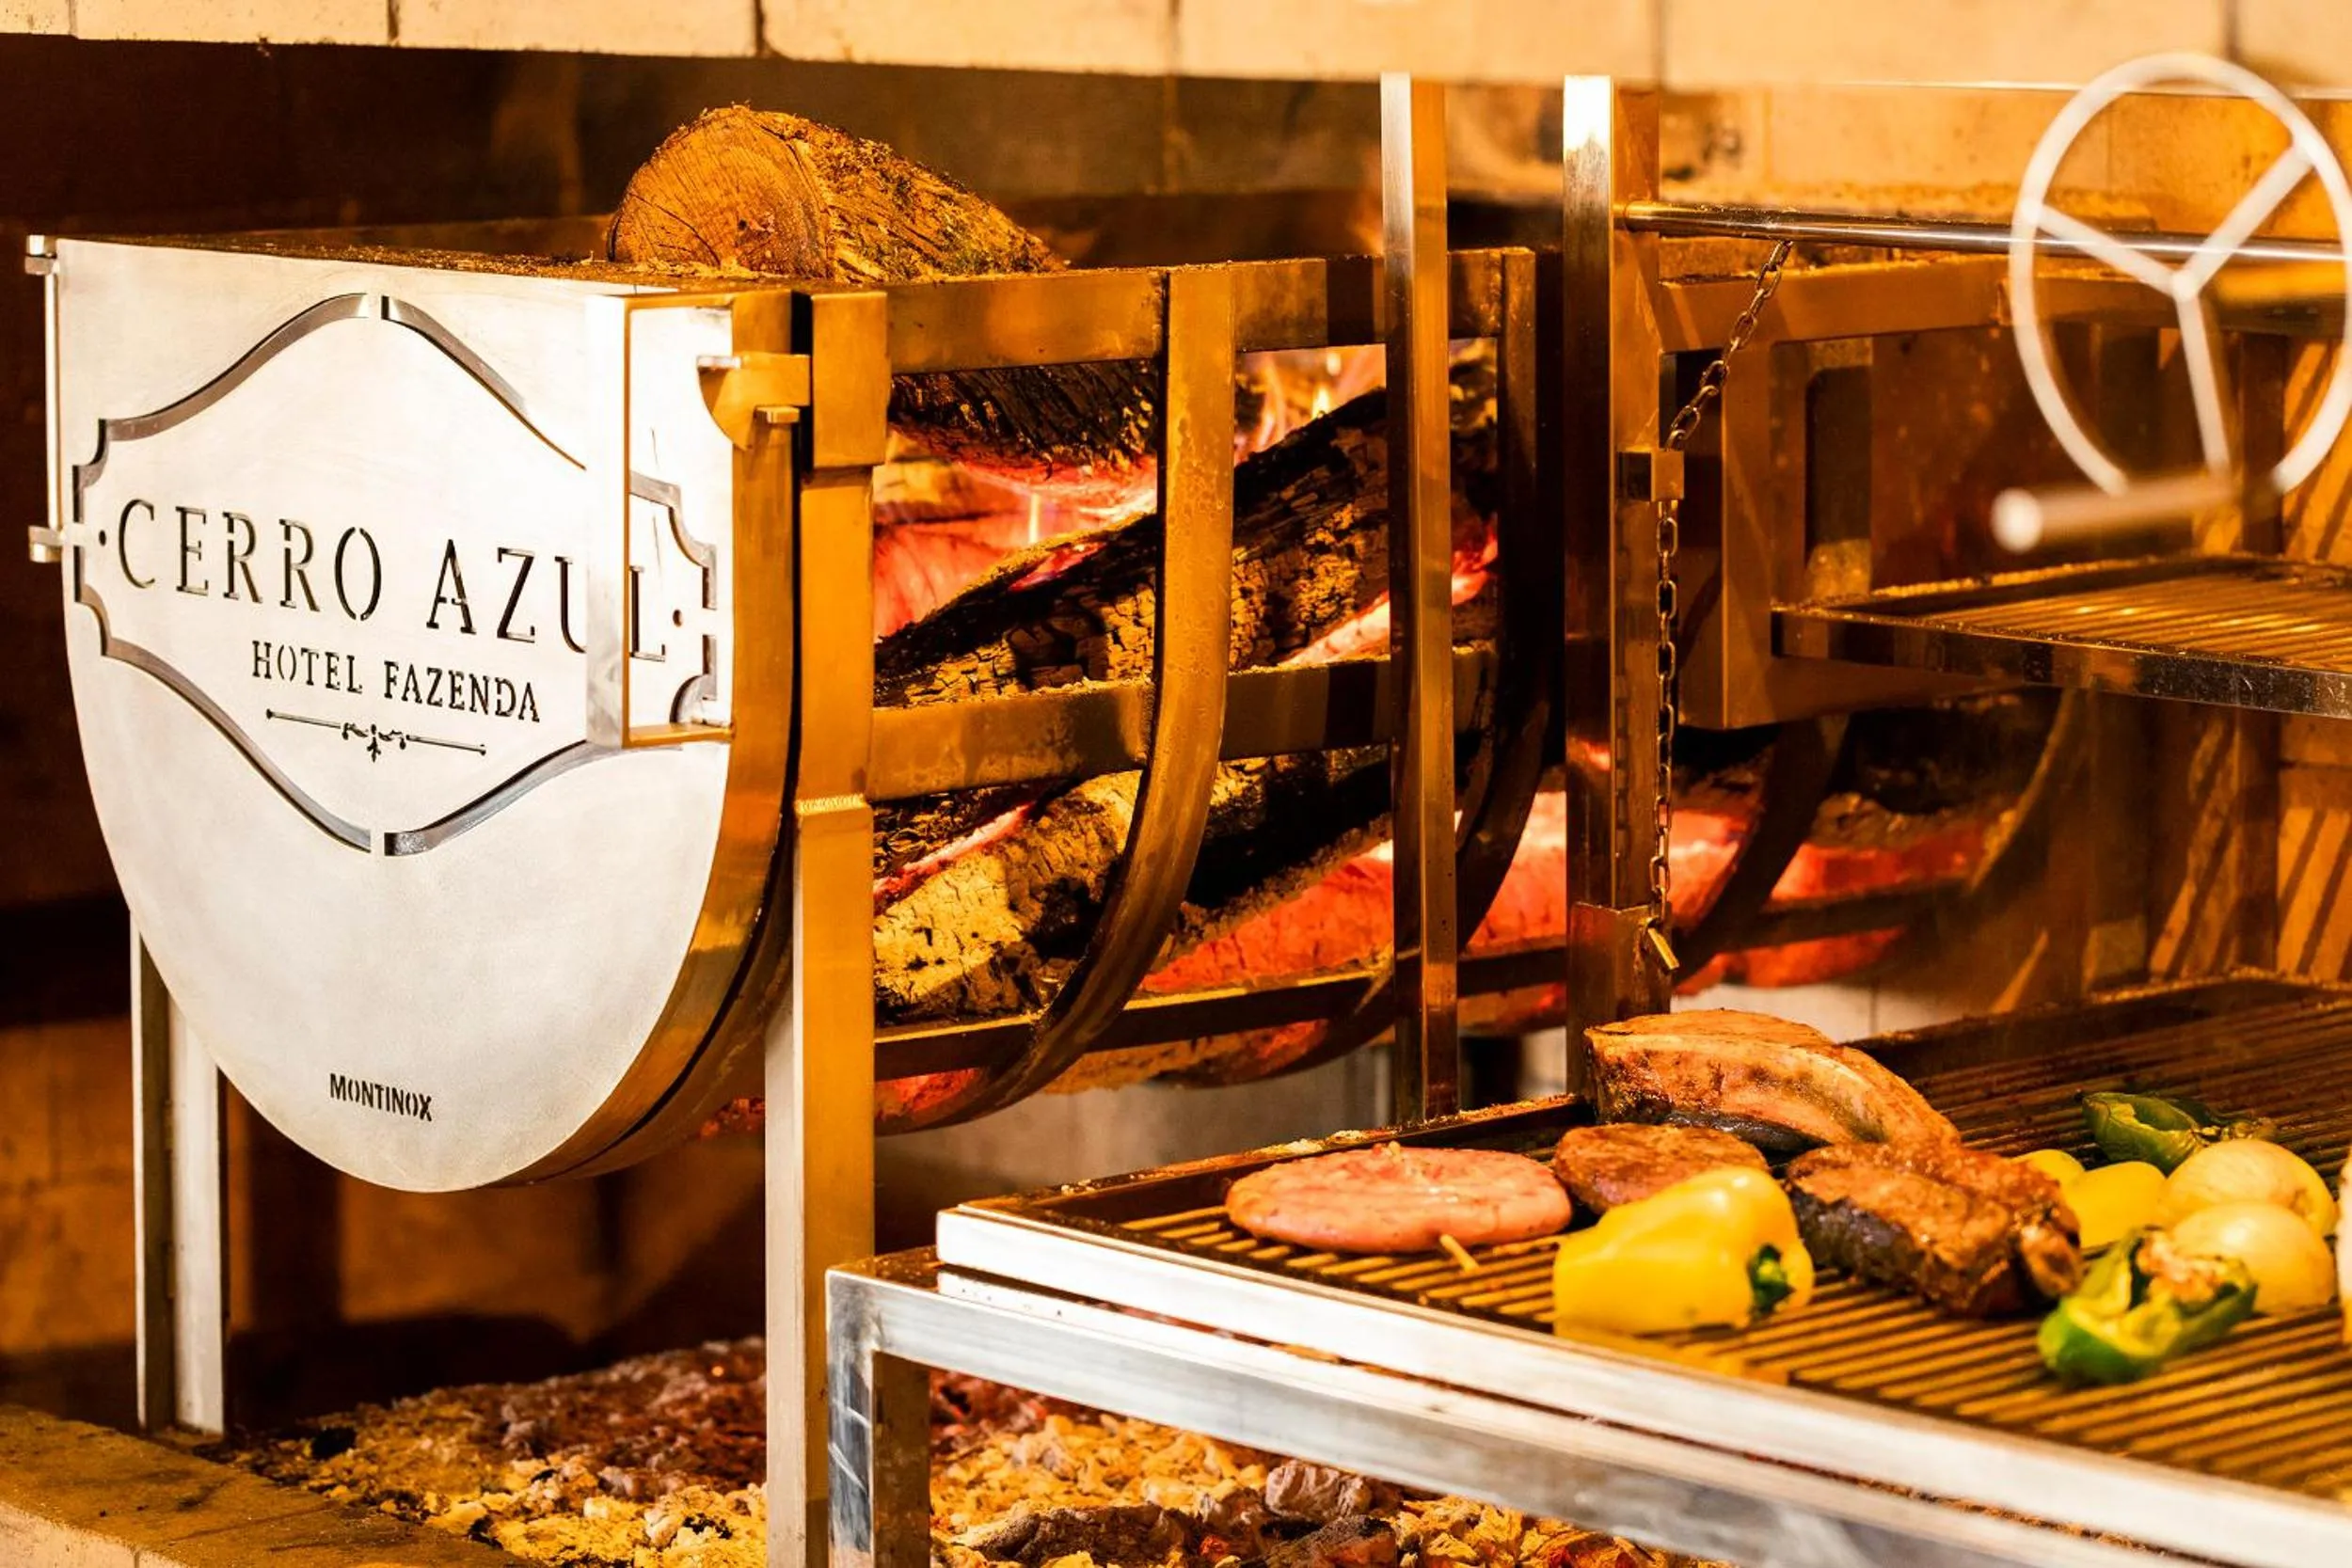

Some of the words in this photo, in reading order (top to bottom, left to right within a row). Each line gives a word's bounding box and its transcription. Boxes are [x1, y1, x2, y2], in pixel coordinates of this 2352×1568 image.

[117, 498, 382, 622] CERRO
[251, 640, 363, 694] HOTEL
[383, 660, 540, 722] FAZENDA
[330, 1072, 432, 1121] MONTINOX
